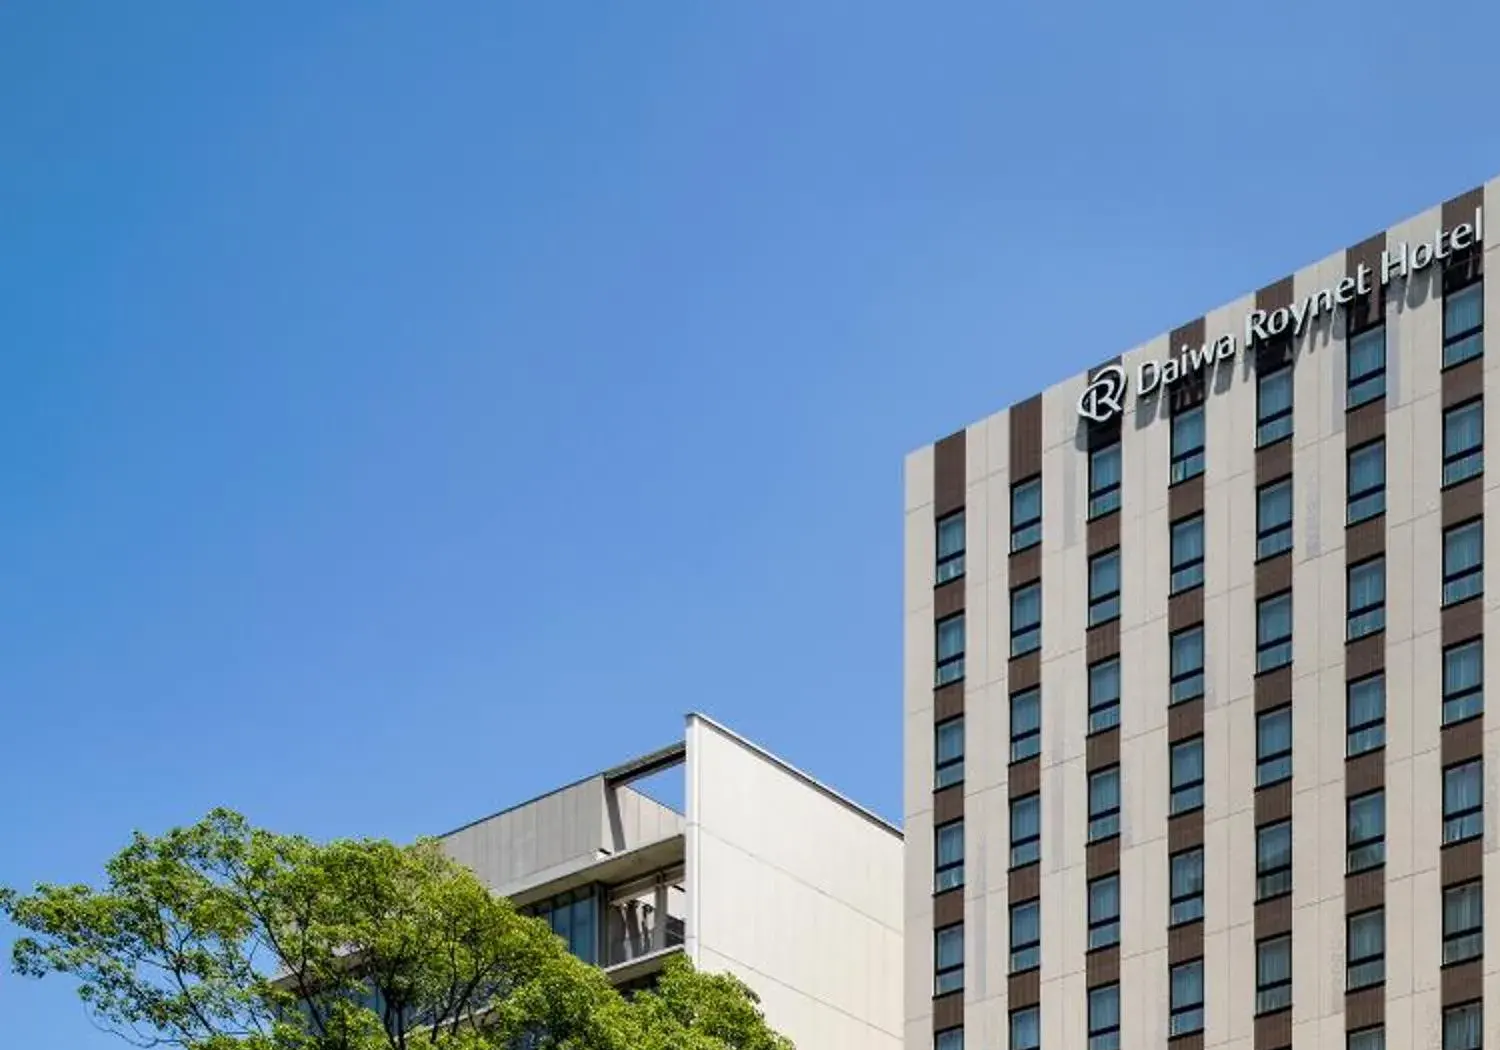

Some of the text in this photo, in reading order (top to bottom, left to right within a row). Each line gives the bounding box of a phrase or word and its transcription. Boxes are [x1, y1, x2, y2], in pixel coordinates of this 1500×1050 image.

[1137, 332, 1236, 397] Daiwa
[1245, 264, 1372, 348] Roynet
[1380, 207, 1483, 285] Hotel
